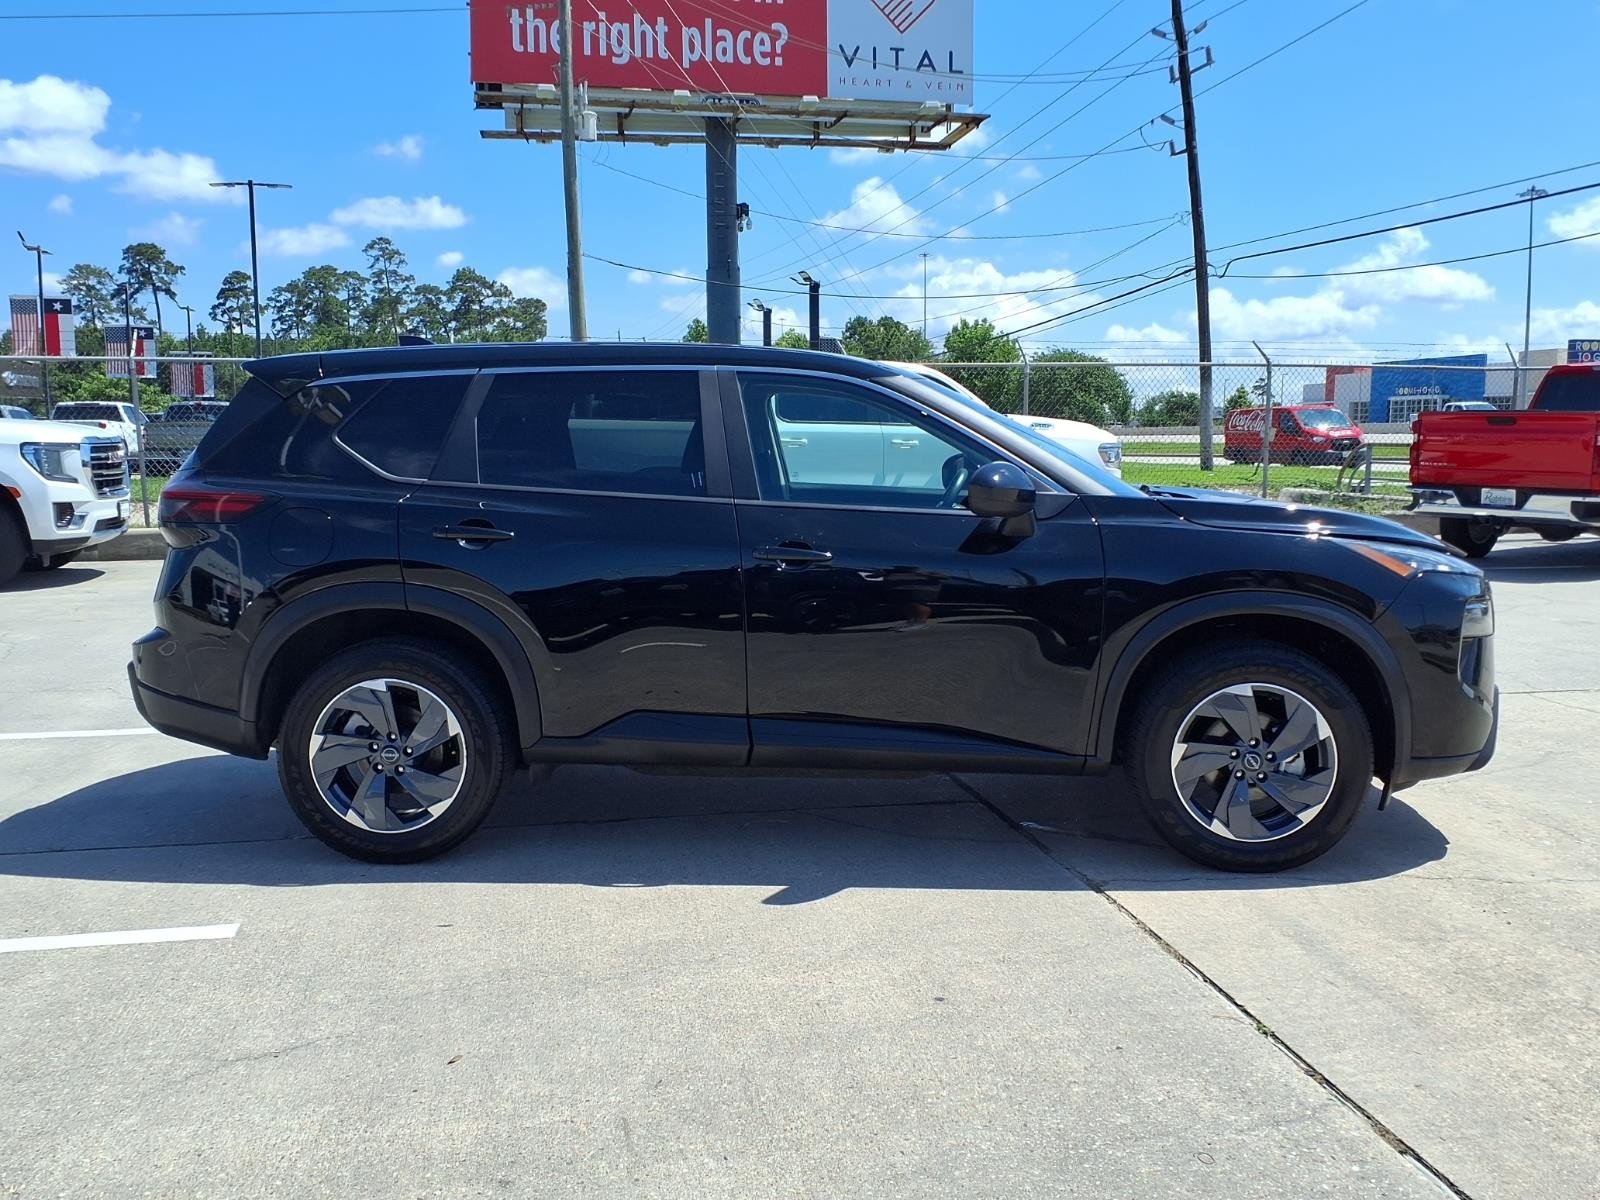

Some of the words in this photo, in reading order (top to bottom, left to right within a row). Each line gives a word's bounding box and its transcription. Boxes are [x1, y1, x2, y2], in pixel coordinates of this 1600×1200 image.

[583, 11, 669, 65] right
[681, 17, 789, 69] place?
[839, 43, 964, 74] VITAL
[839, 76, 892, 88] HEART
[905, 80, 912, 89] &
[925, 81, 964, 92] VEIN
[1575, 341, 1600, 352] ROO
